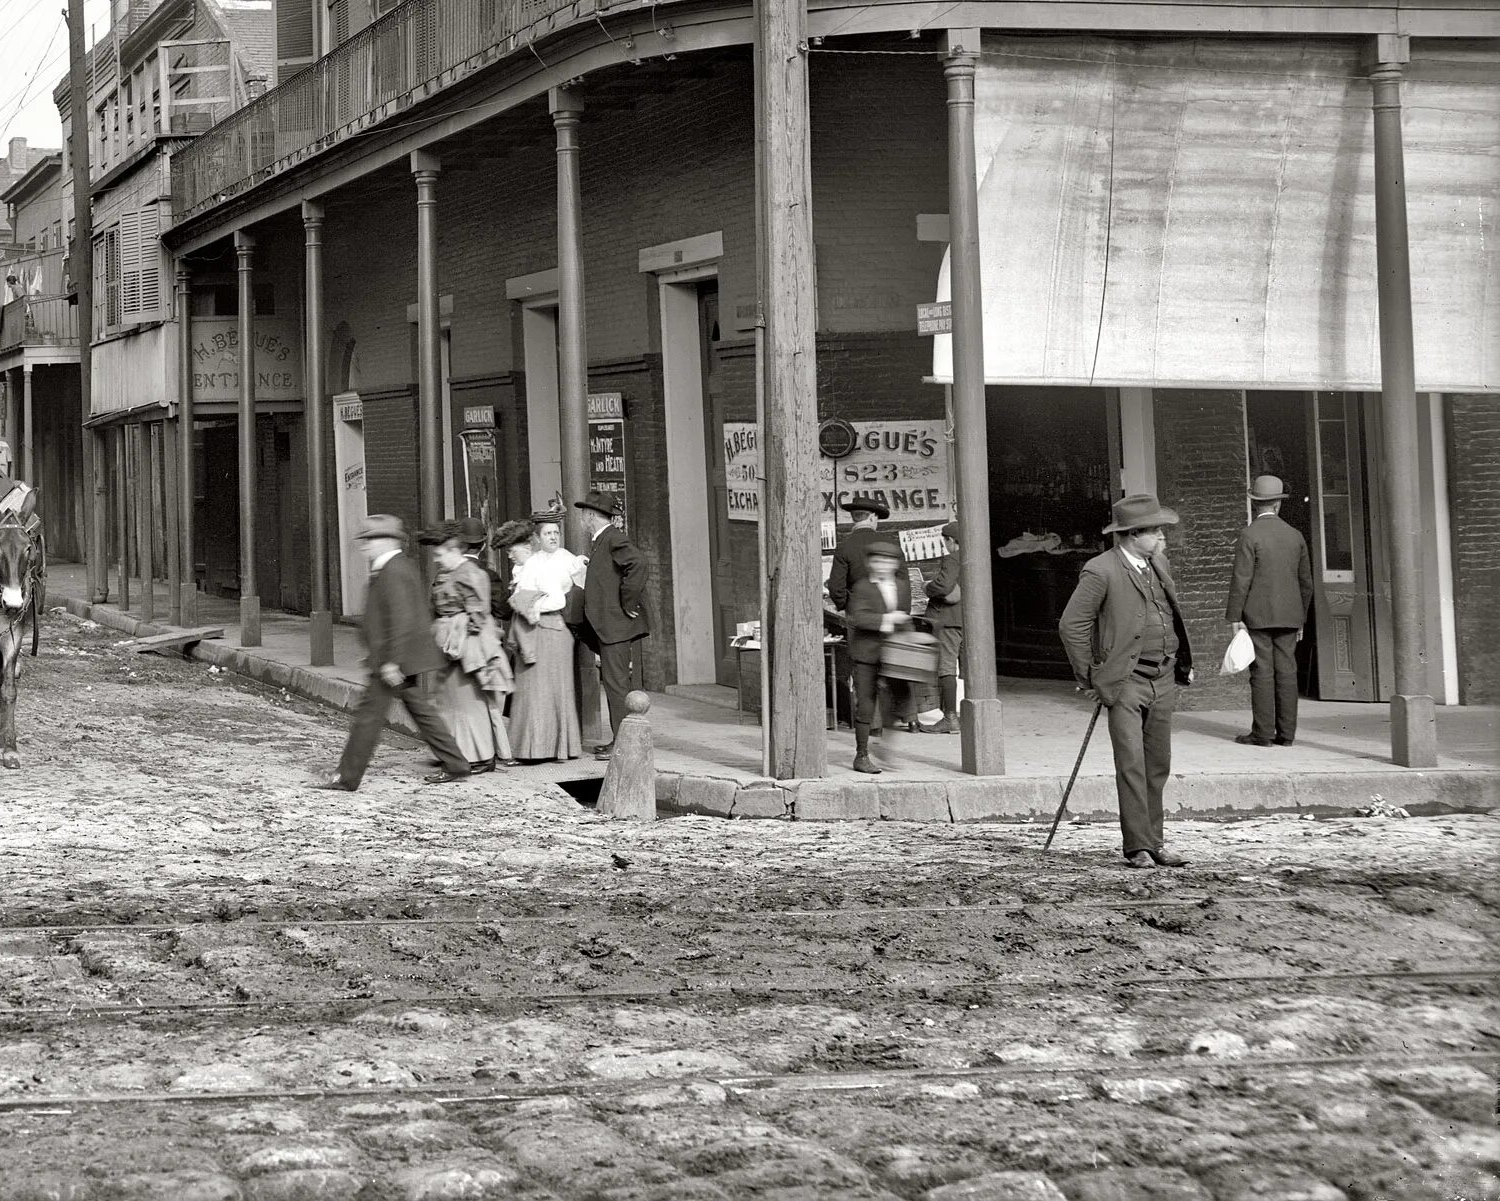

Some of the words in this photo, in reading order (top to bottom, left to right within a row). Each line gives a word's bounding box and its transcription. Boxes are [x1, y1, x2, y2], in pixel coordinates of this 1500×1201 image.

[193, 372, 298, 389] ENTNCE.
[465, 409, 493, 423] GARLICK
[605, 454, 624, 472] HEATH
[844, 463, 898, 482] 823
